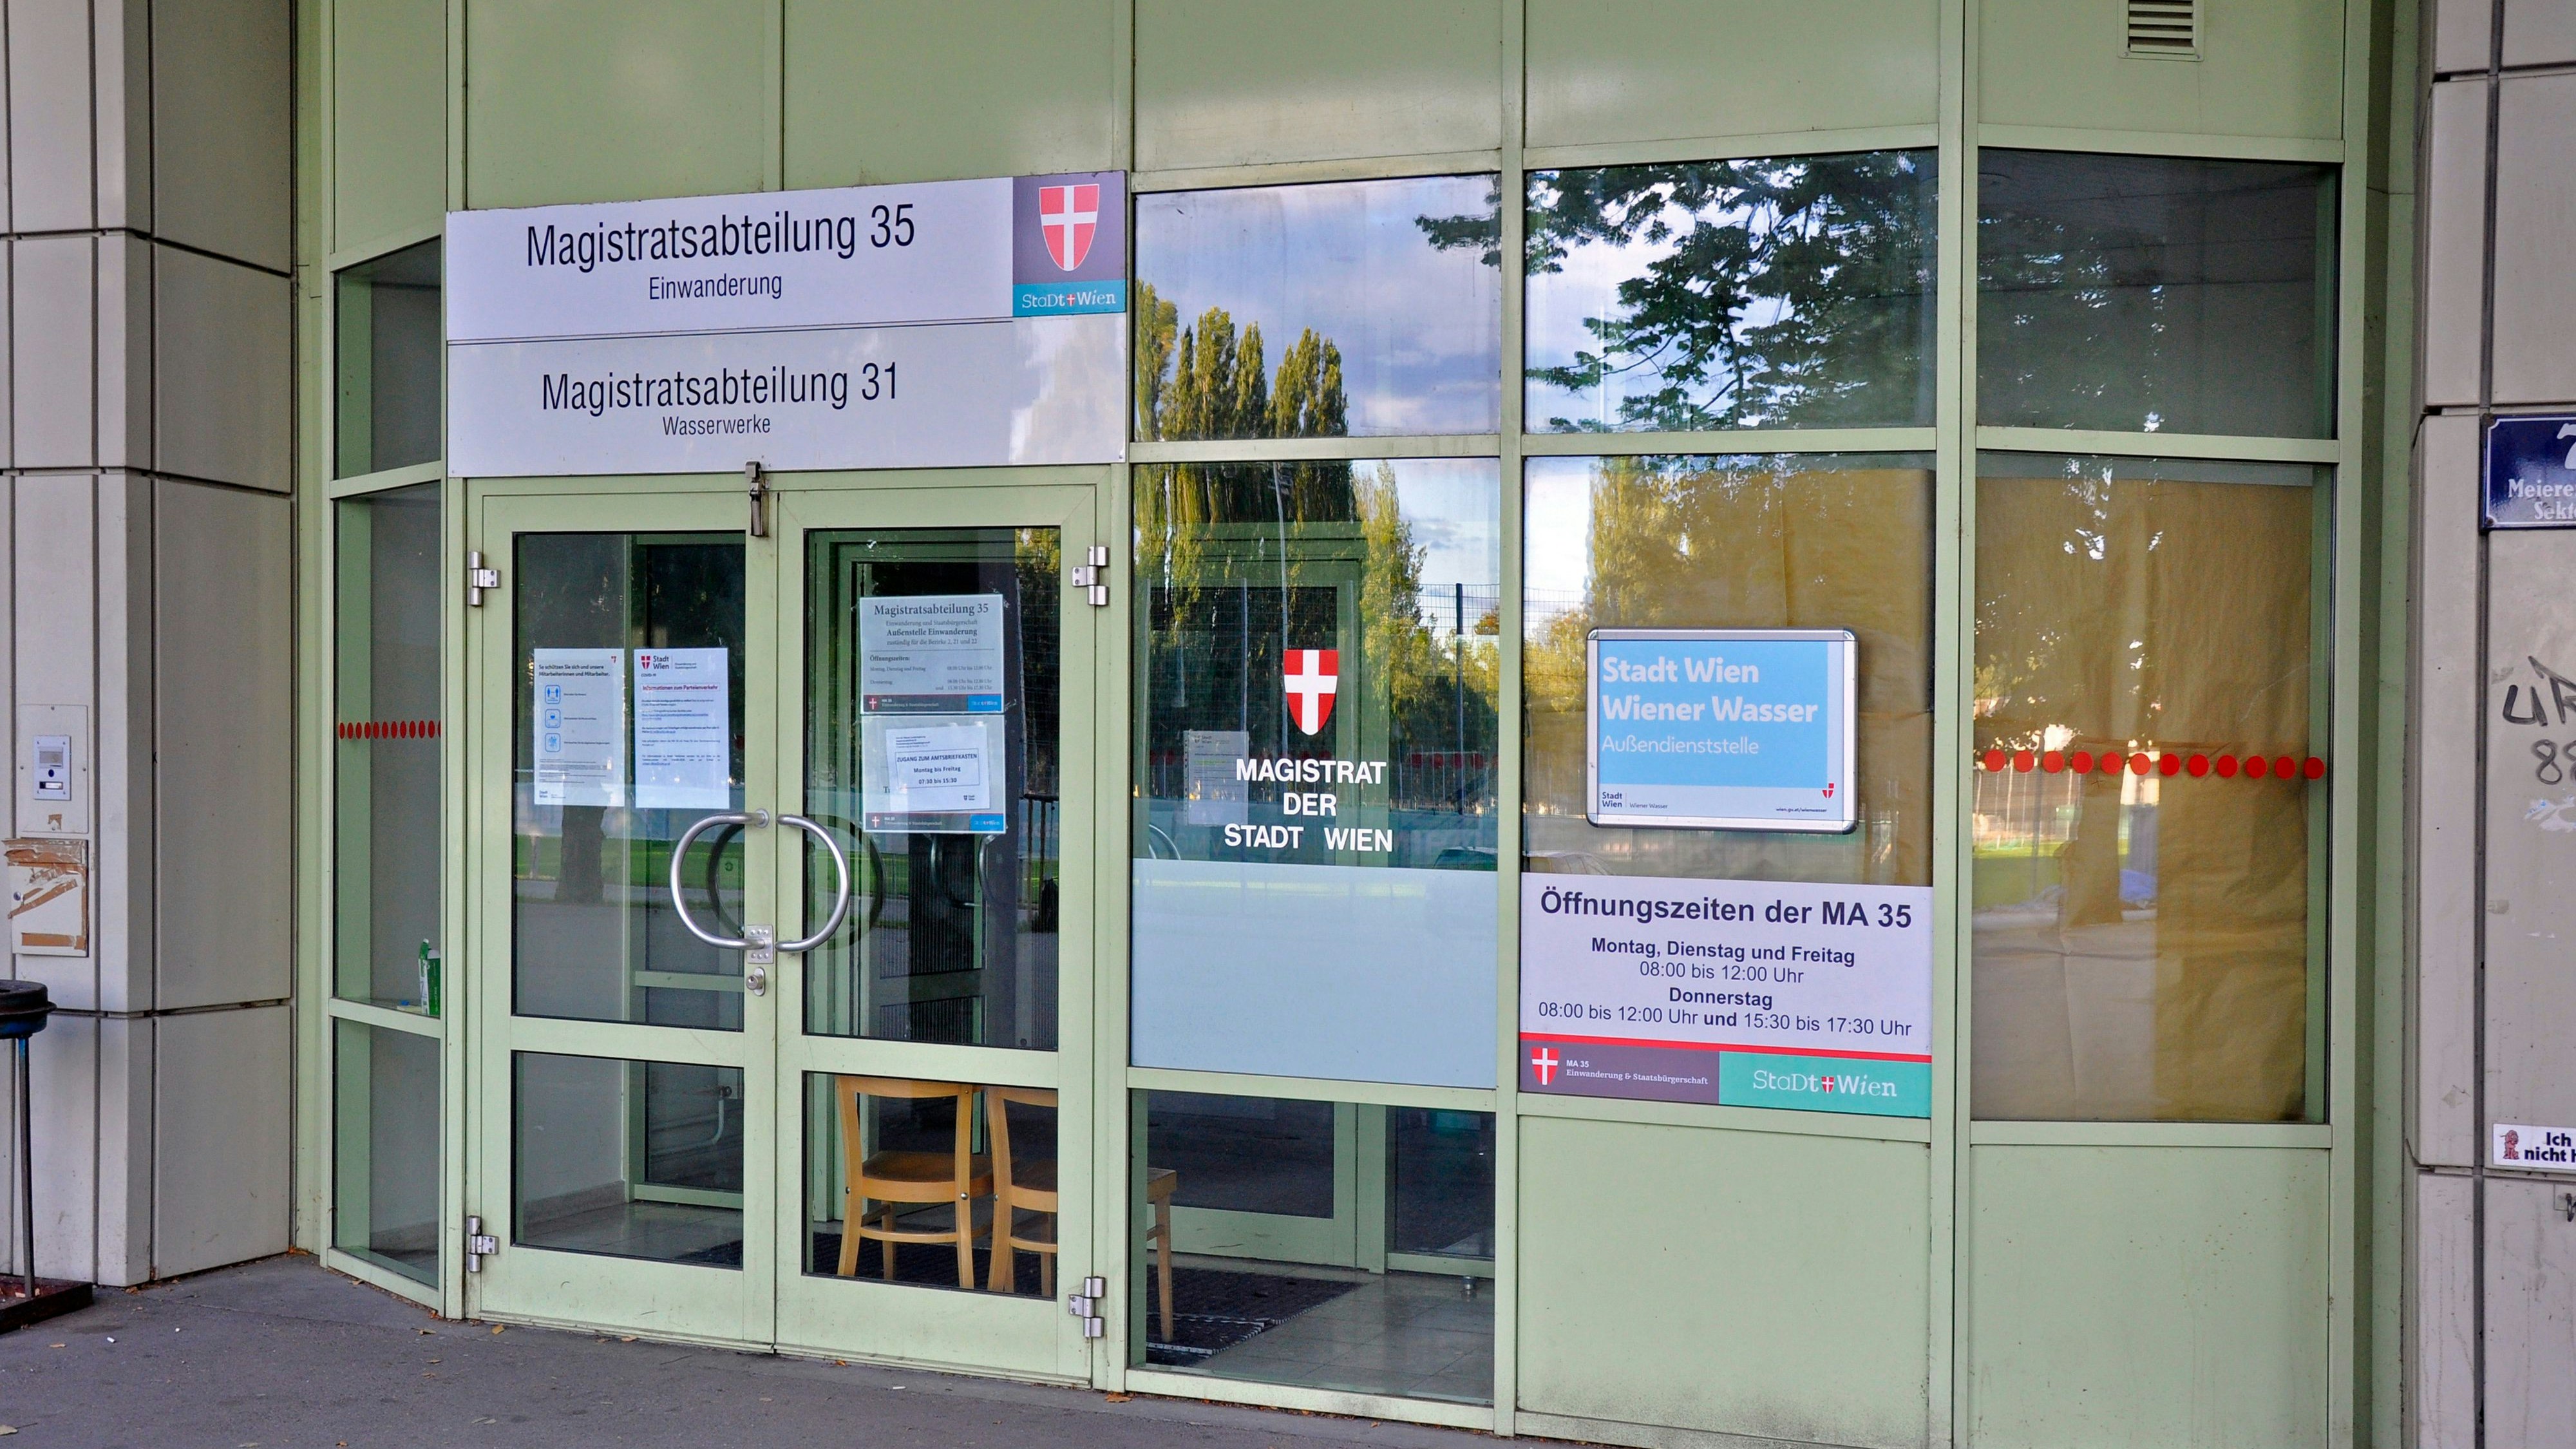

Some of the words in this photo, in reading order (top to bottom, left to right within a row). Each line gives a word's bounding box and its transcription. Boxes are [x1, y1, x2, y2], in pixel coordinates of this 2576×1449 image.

[527, 207, 856, 273] Magistratsabteilung
[869, 204, 915, 249] 35
[649, 272, 783, 301] Einwanderung
[1076, 289, 1116, 306] Wien
[542, 362, 848, 417] Magistratsabteilung
[860, 361, 898, 400] 31
[662, 414, 772, 438] Wasserwerke
[2508, 478, 2576, 498] Meiere
[2534, 501, 2576, 520] Sekt
[874, 603, 974, 618] Magistratsabteilung
[977, 603, 989, 613] 35
[887, 628, 927, 636] Außenstelle
[928, 628, 978, 636] Einwanderung
[1602, 656, 1678, 683] Stadt
[1684, 656, 1759, 683] Wien
[1602, 695, 1705, 721] Wiener
[1711, 696, 1817, 722] Wasser
[1602, 734, 1759, 755] Außendienststelle
[1236, 759, 1387, 784] MAGISTRAT
[1283, 792, 1337, 817] DER
[1224, 823, 1304, 849] STADT
[1323, 827, 1393, 853] WIEN
[1540, 886, 1755, 923] Öffnungszeiten
[1765, 900, 1812, 923] der
[1821, 902, 1870, 927] MA
[1877, 904, 1912, 928] 35
[1591, 938, 1661, 957] Montag,
[1667, 940, 1745, 962] Dienstag
[1751, 945, 1786, 960] und
[1792, 946, 1855, 967] Freitag
[1640, 961, 1686, 978] 08:00
[1691, 962, 1715, 980] bis
[1722, 965, 1768, 982] 12:00
[1773, 966, 1804, 983] Uhr
[1669, 987, 1774, 1010] Donnerstag
[1538, 1001, 1583, 1019] 08:00
[1589, 1003, 1612, 1021] bis
[1618, 1005, 1663, 1023] 12:00
[1669, 1008, 1699, 1025] Uhr
[1703, 1010, 1738, 1028] und
[1744, 1012, 1790, 1030] 15:30
[1795, 1015, 1821, 1032] bis
[1826, 1017, 1874, 1034] 17:30
[1880, 1019, 1912, 1036] Uhr
[1566, 1069, 1623, 1081] Einwanderung
[1633, 1073, 1709, 1084] Staatsbürgerschaft
[1835, 1074, 1897, 1097] Wien
[2546, 1132, 2571, 1147] Ich
[2524, 1146, 2566, 1162] nicht
